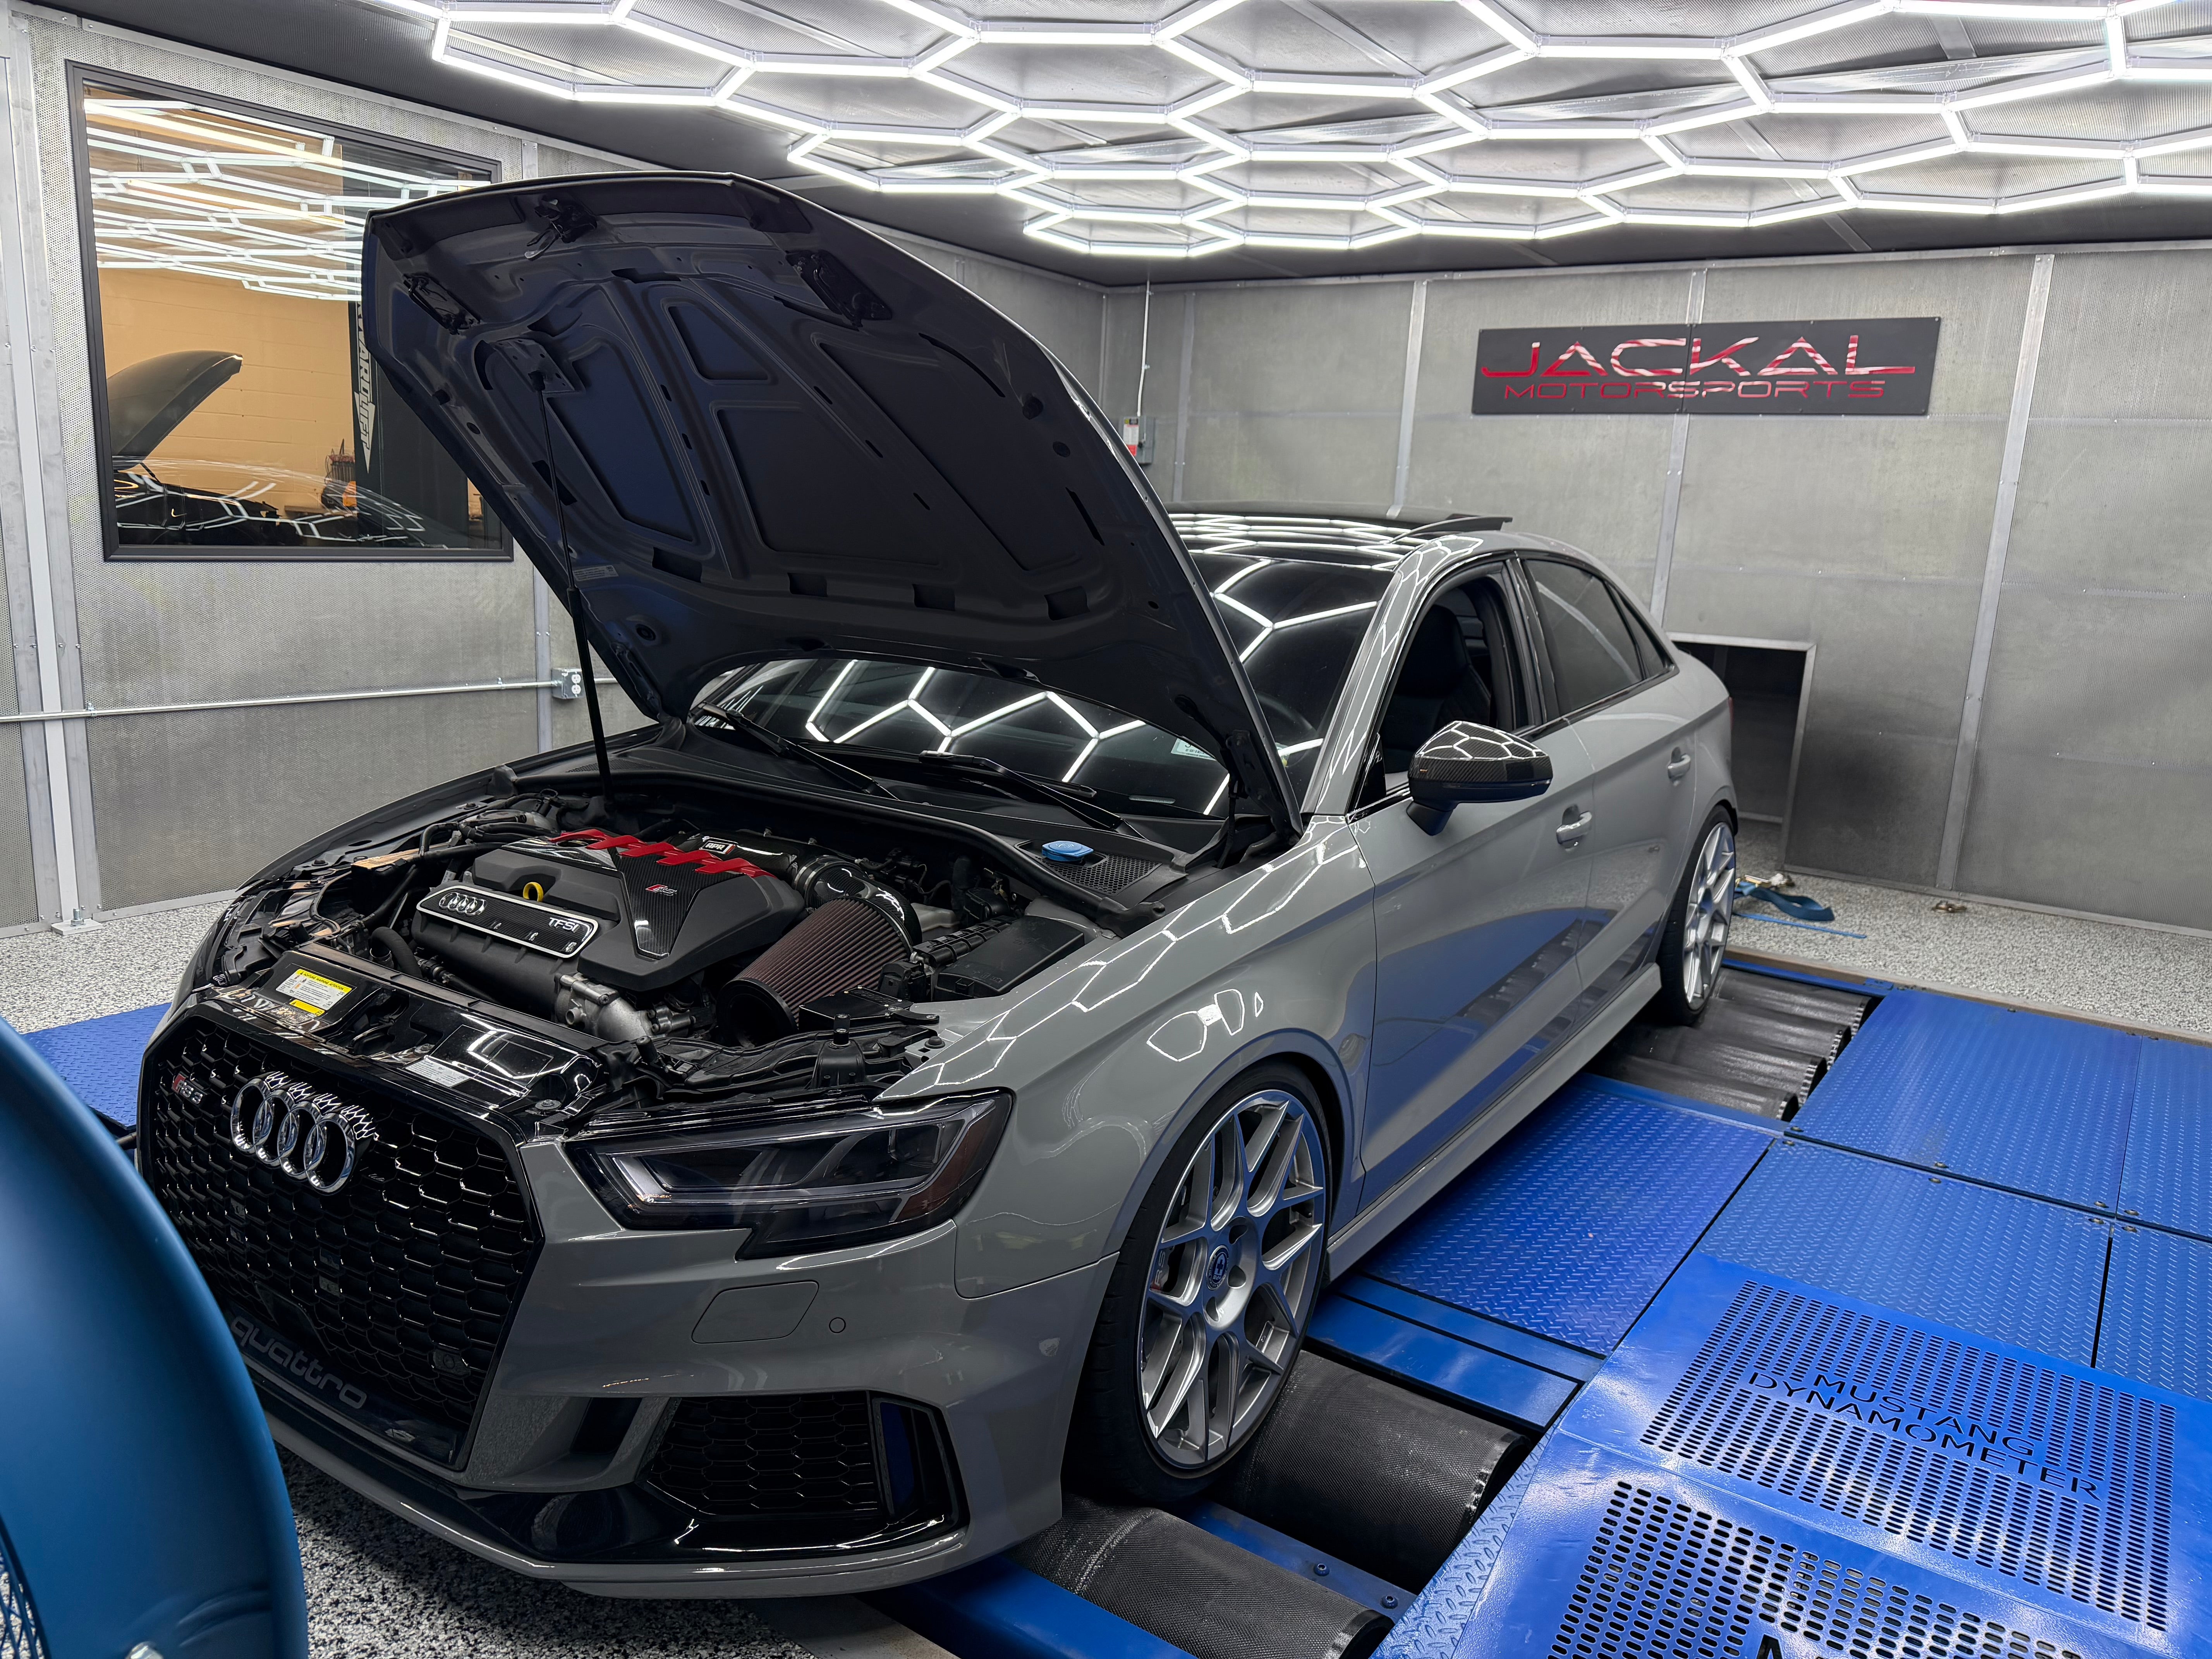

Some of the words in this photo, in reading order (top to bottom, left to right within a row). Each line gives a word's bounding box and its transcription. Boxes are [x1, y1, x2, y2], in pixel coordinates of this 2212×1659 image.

[1481, 335, 1915, 378] JACKAL
[1504, 380, 1885, 399] MOTORSPORTS
[359, 392, 370, 450] LIFT
[705, 842, 725, 850] APR
[548, 917, 580, 933] TFSI
[1154, 1250, 1166, 1286] RS
[232, 1316, 367, 1409] quattro
[1813, 1374, 2035, 1456] MUSTANG
[1748, 1372, 2103, 1502] DYNAMOMETER
